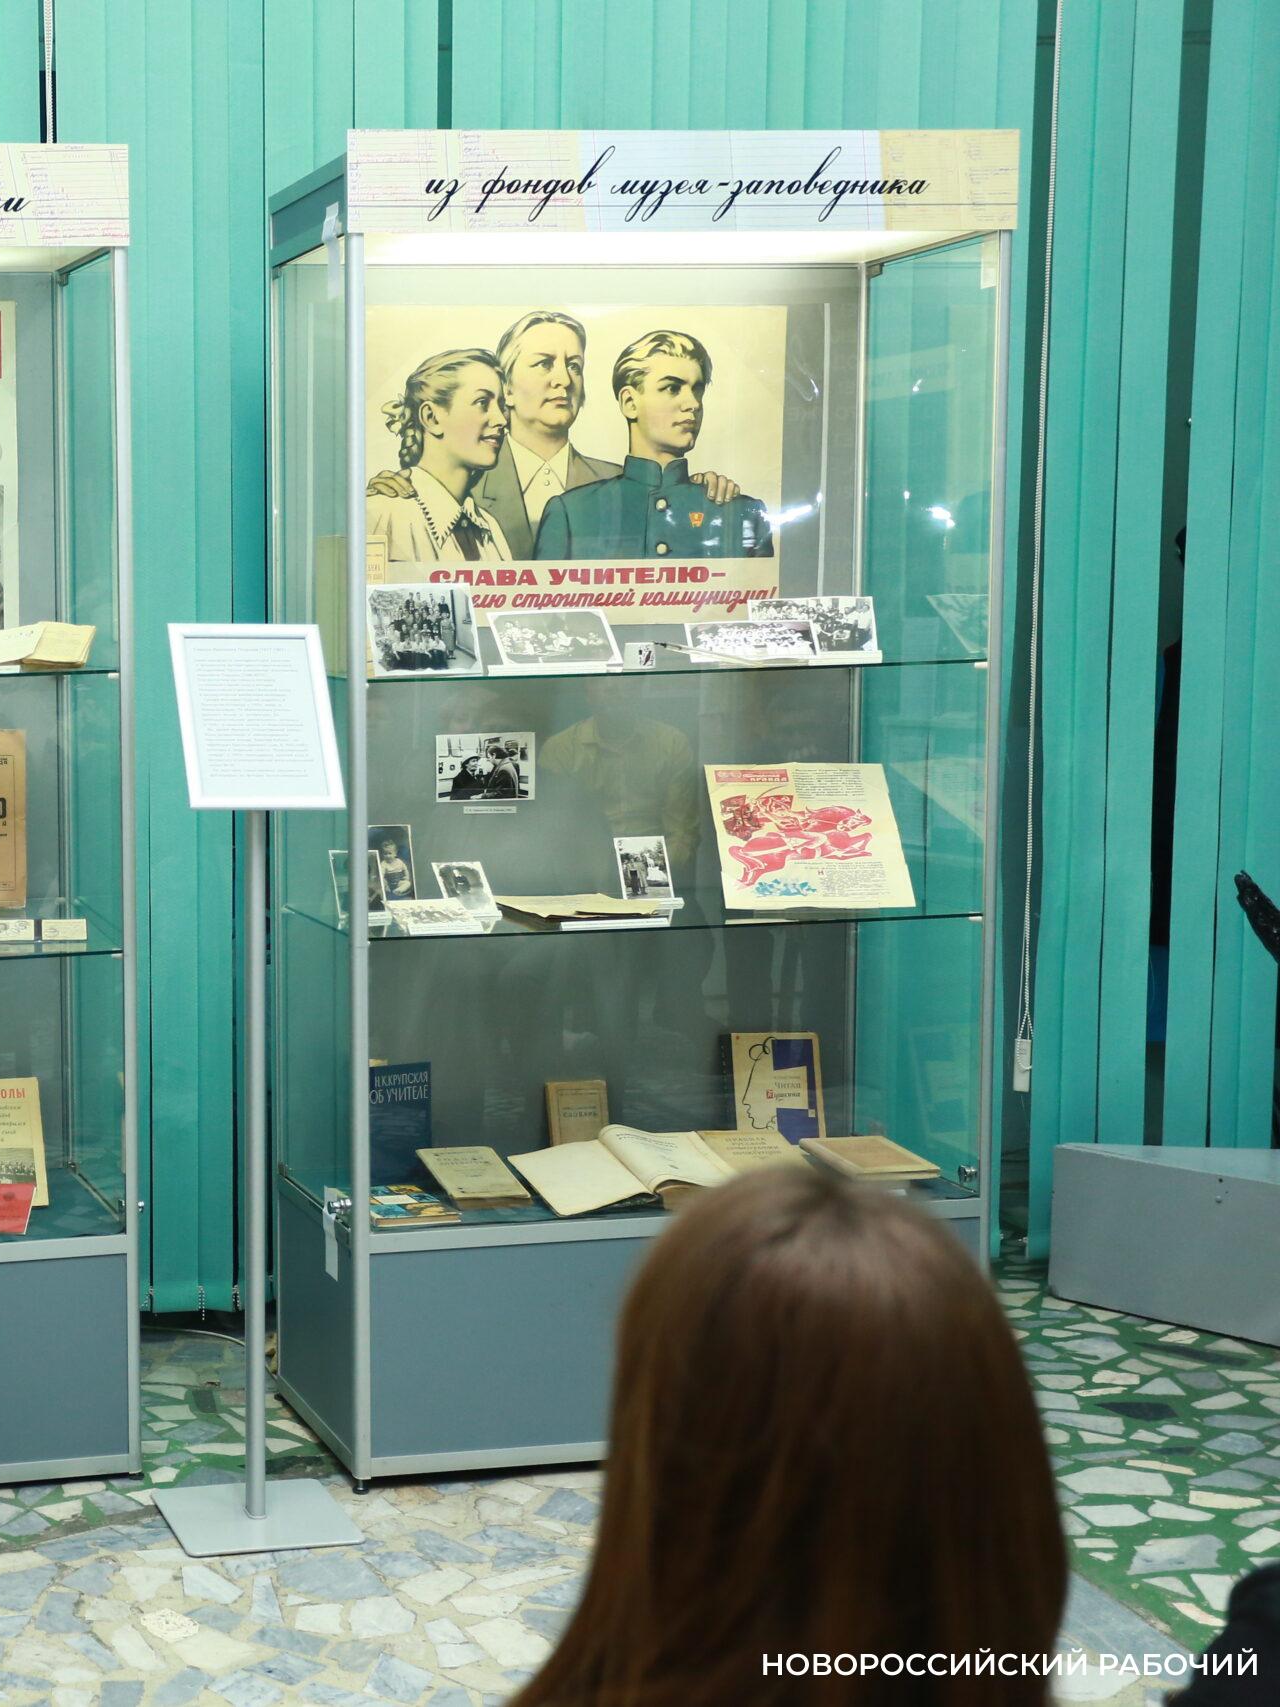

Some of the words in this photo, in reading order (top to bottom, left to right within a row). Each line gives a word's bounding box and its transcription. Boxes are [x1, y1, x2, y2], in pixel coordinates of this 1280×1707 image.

[424, 178, 466, 222] из
[481, 145, 616, 222] фондов
[610, 145, 931, 223] музея-заповедника
[429, 569, 538, 587] СЛАВА
[511, 587, 635, 610] строителей
[639, 585, 778, 613] коммунизма!
[370, 1088, 384, 1105] ОБ
[387, 1084, 429, 1103] УЧИТЕЛЕ
